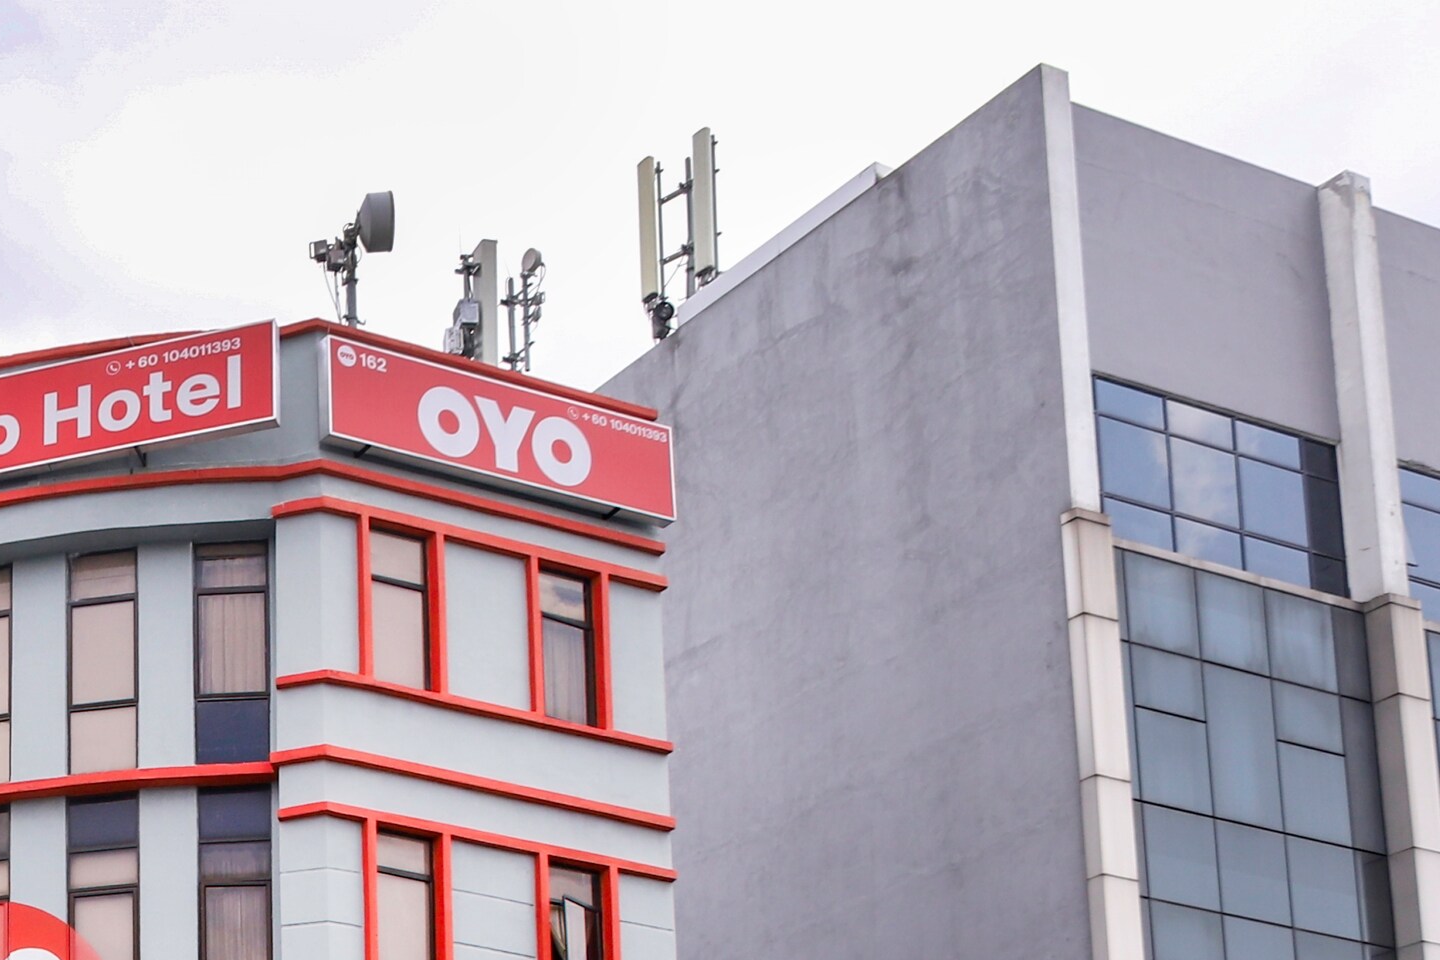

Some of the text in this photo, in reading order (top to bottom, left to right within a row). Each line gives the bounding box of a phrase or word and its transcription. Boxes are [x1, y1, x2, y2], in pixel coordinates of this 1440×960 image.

[138, 354, 158, 368] 60
[162, 337, 241, 363] 104011393
[359, 353, 387, 373] 162
[43, 354, 242, 446] Hotel
[417, 386, 592, 487] OYO
[592, 413, 607, 427] 60
[610, 418, 668, 443] 104011393
